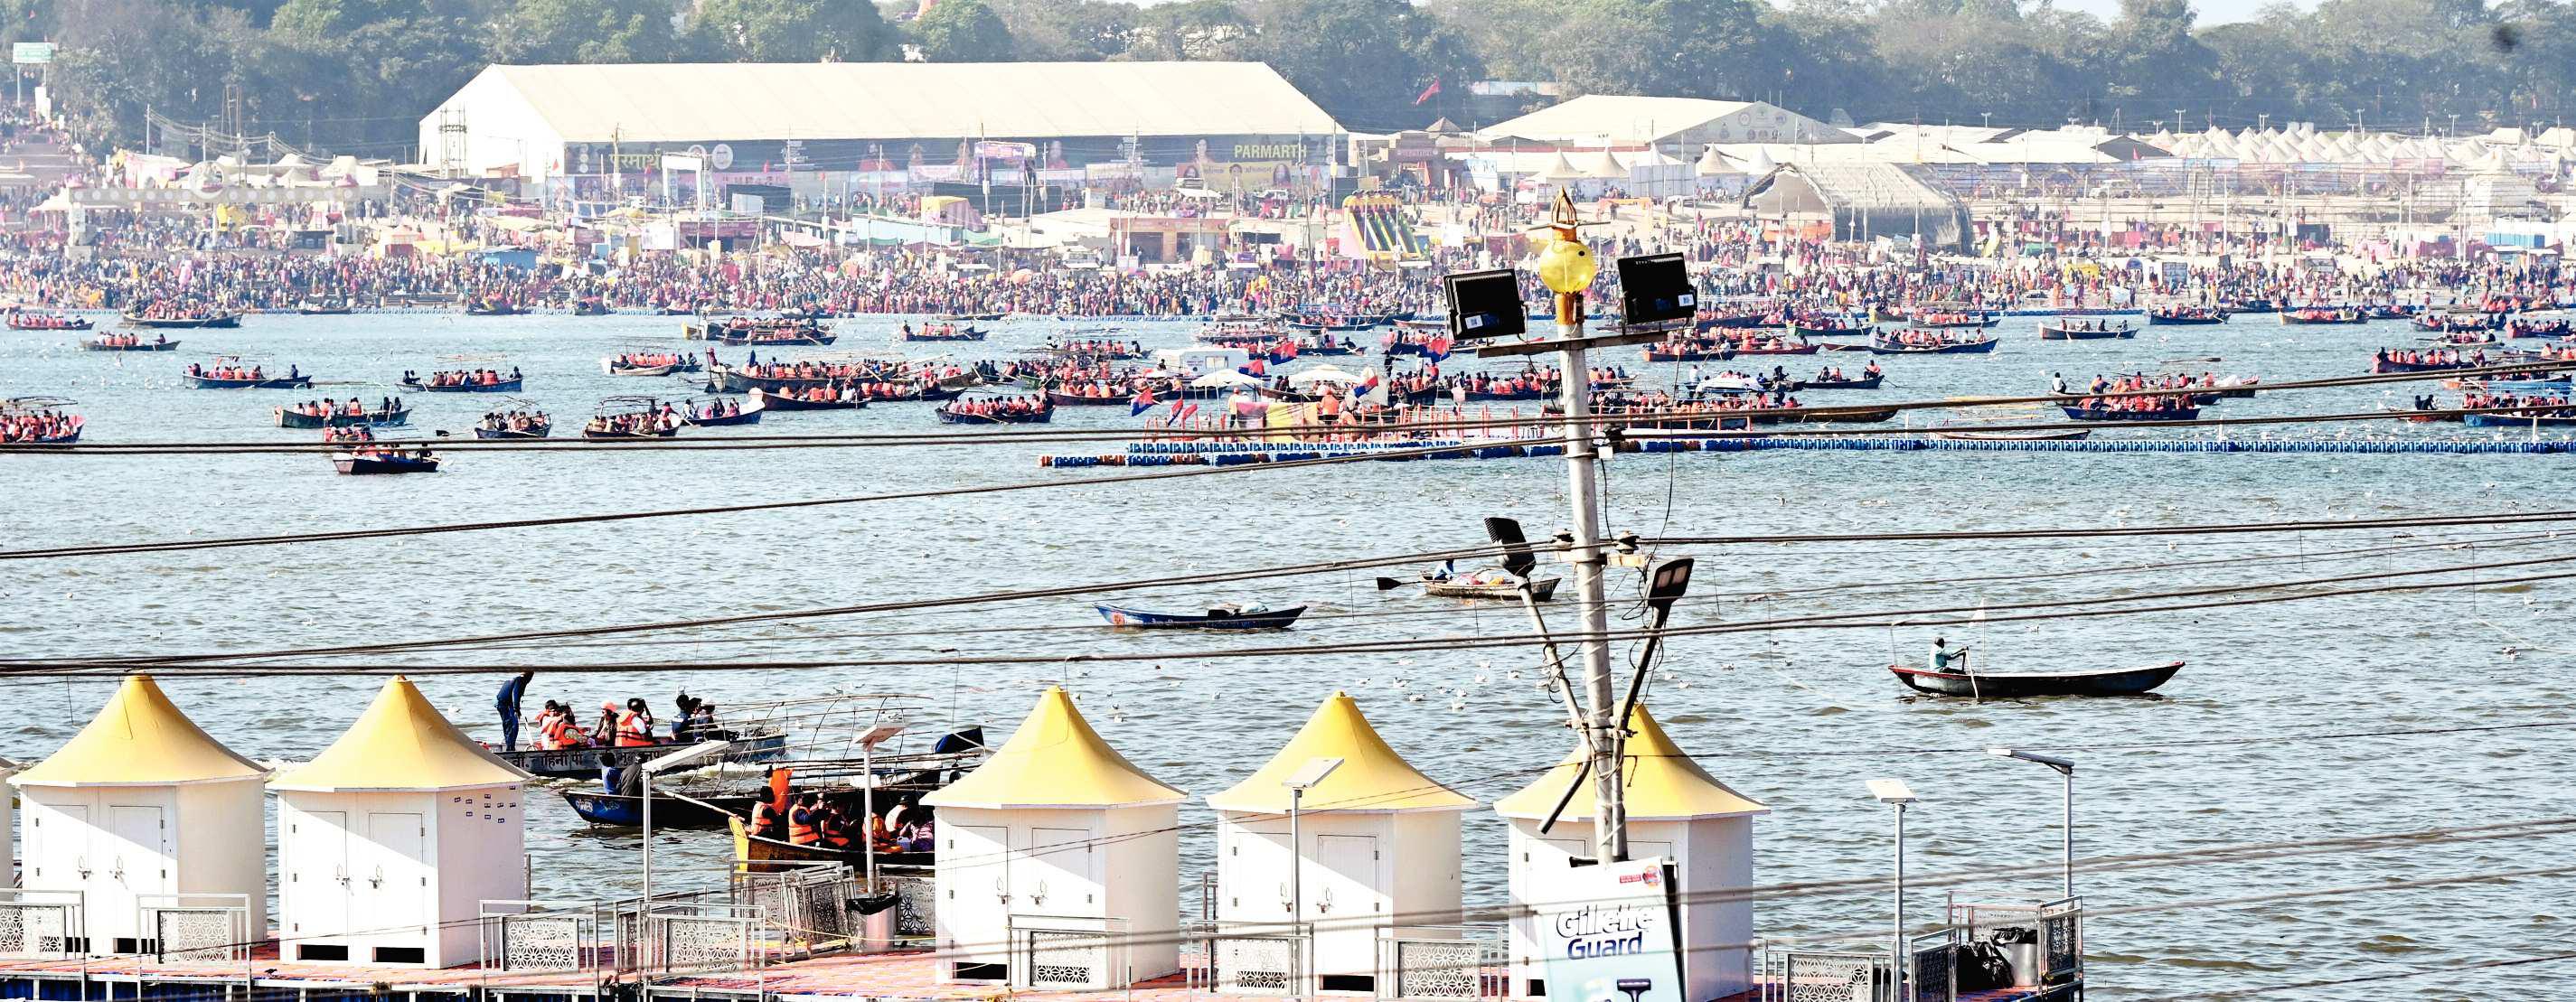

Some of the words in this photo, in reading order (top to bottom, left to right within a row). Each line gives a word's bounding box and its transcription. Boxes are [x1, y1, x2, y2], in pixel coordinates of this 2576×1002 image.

[1234, 144, 1307, 159] PARMARTH
[1556, 903, 1654, 939] Gillette
[1567, 931, 1643, 960] Guard
